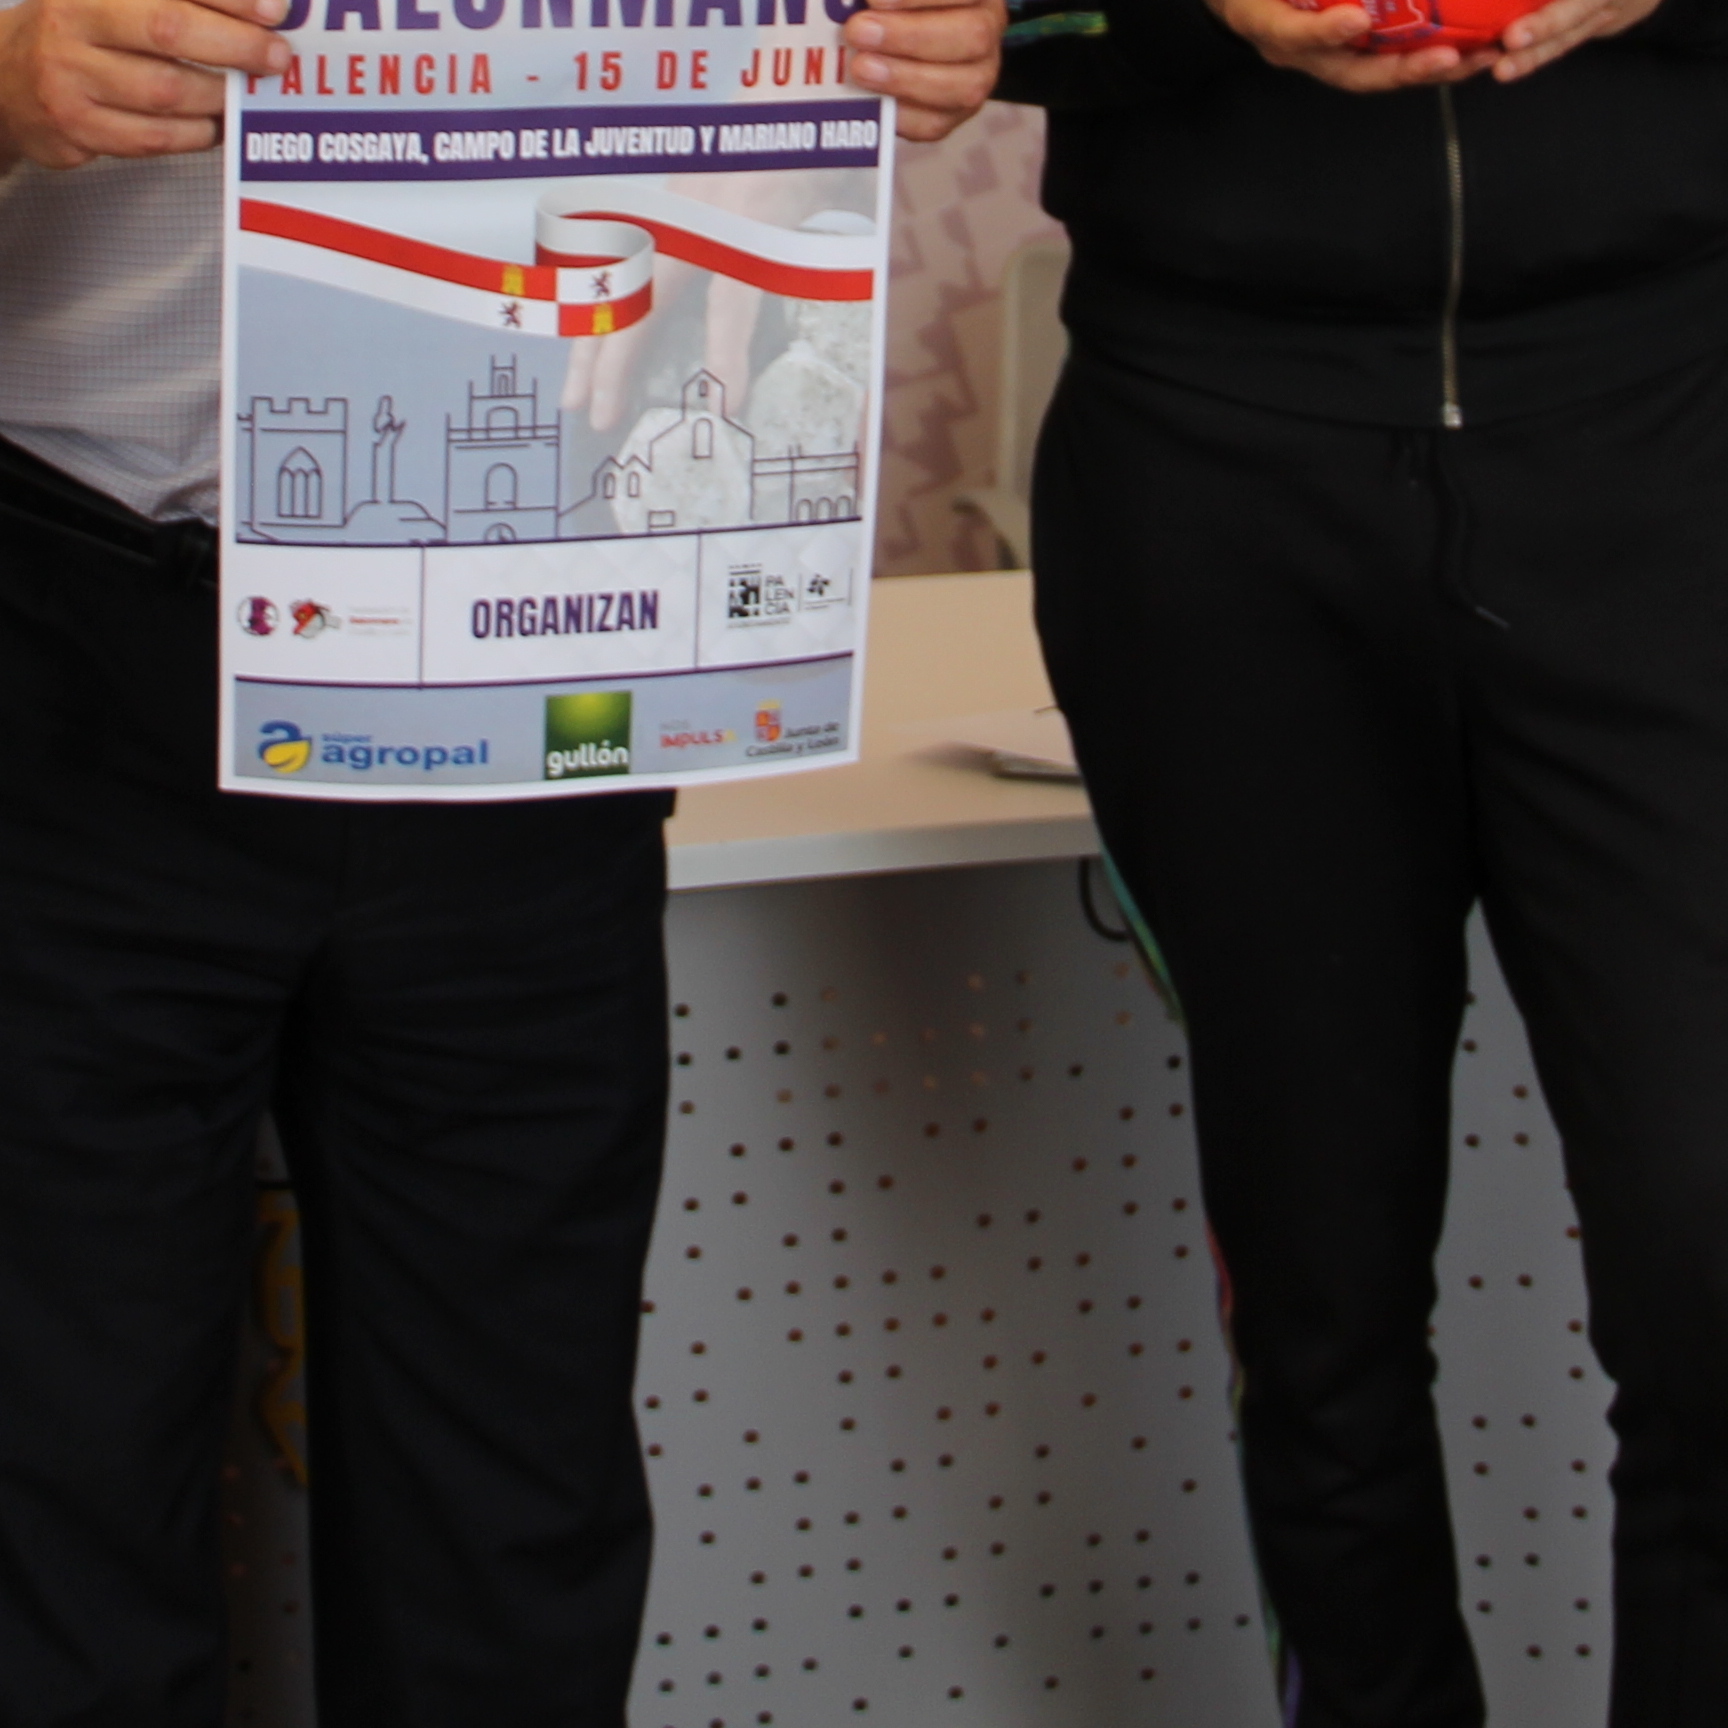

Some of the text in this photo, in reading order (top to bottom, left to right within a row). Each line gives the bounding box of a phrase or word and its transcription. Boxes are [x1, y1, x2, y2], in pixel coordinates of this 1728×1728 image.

[574, 52, 621, 91] 15
[656, 51, 708, 90] DE
[740, 45, 846, 88] JUNI
[246, 120, 878, 165] DIEGO COSGAYA, CAMPO DE LA JUVENTUD Y MARIANO HARO
[471, 589, 660, 639] ORGANIZAN
[321, 738, 489, 769] agropal
[547, 740, 628, 775] gullón
